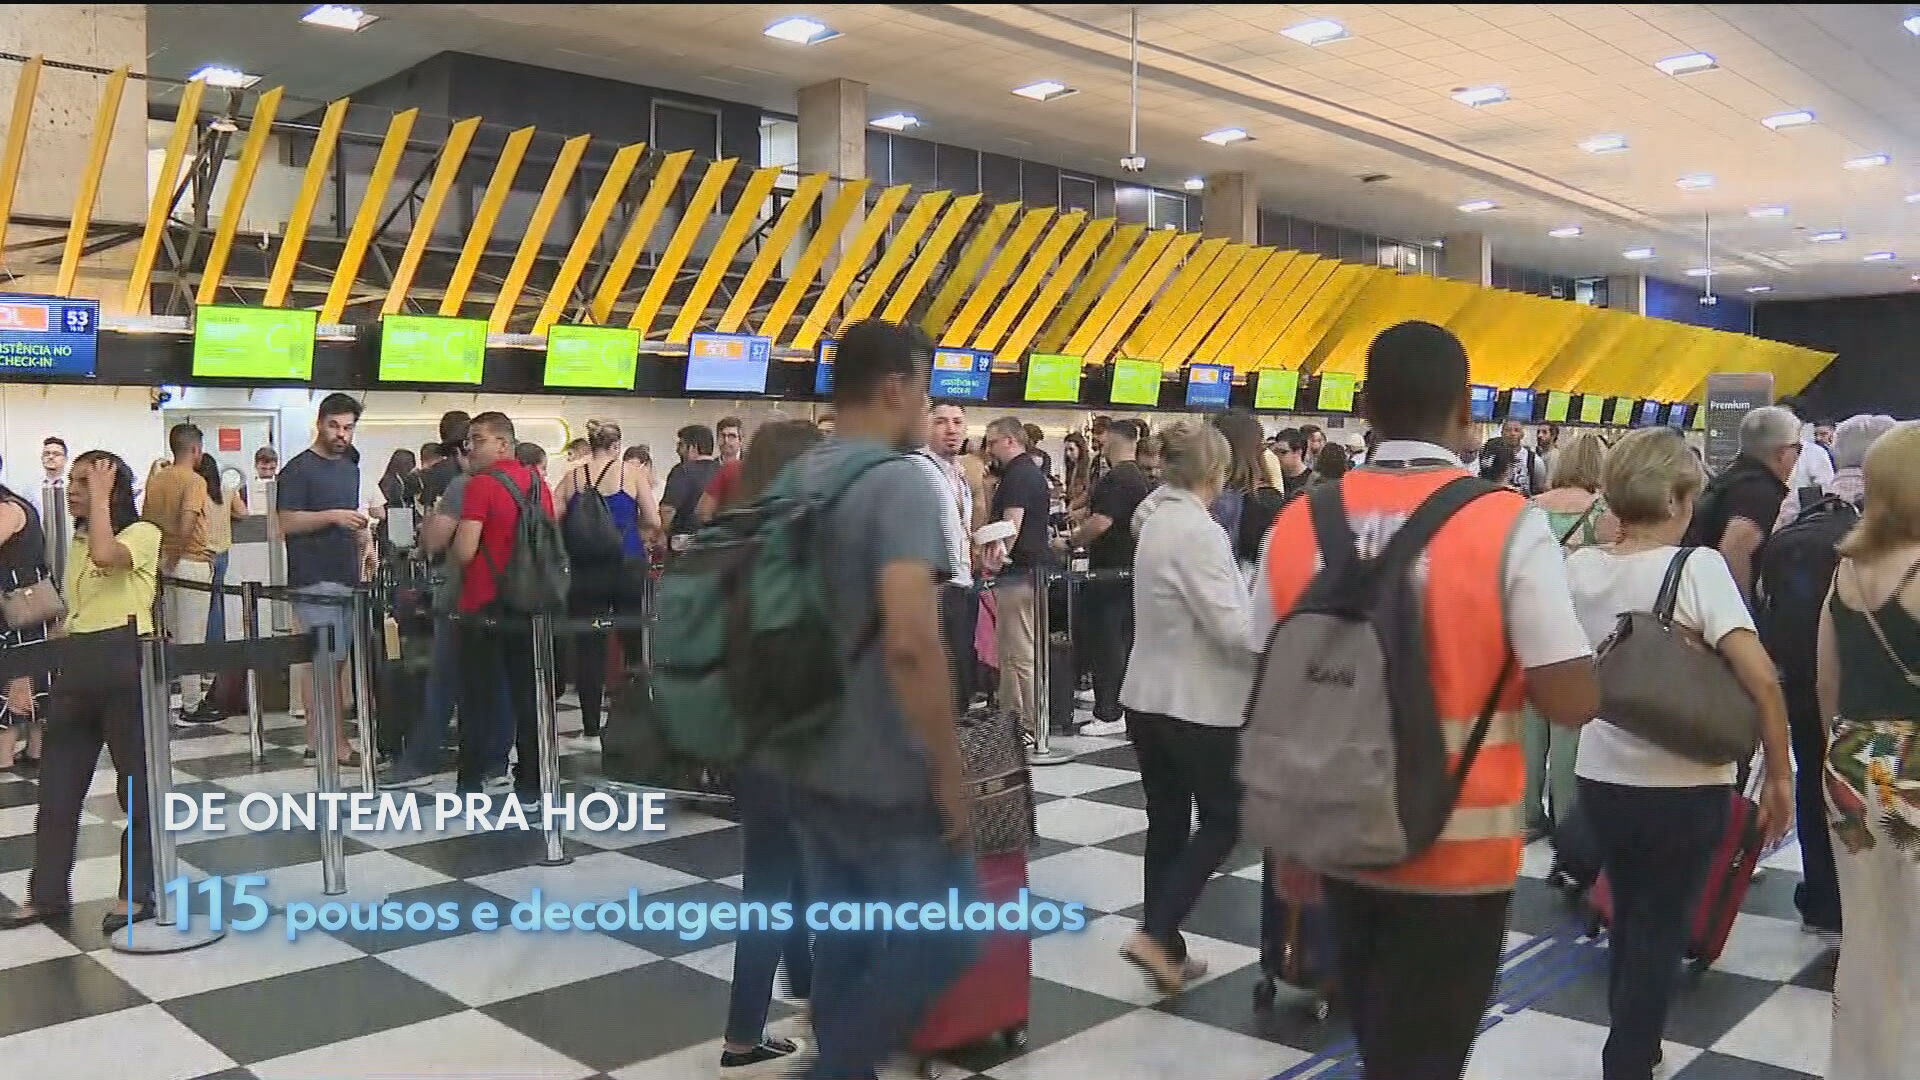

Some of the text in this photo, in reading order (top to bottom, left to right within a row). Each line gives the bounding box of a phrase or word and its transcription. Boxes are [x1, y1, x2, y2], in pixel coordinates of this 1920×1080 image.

[66, 310, 89, 326] 53
[53, 345, 72, 356] NO
[1710, 400, 1750, 410] Premium
